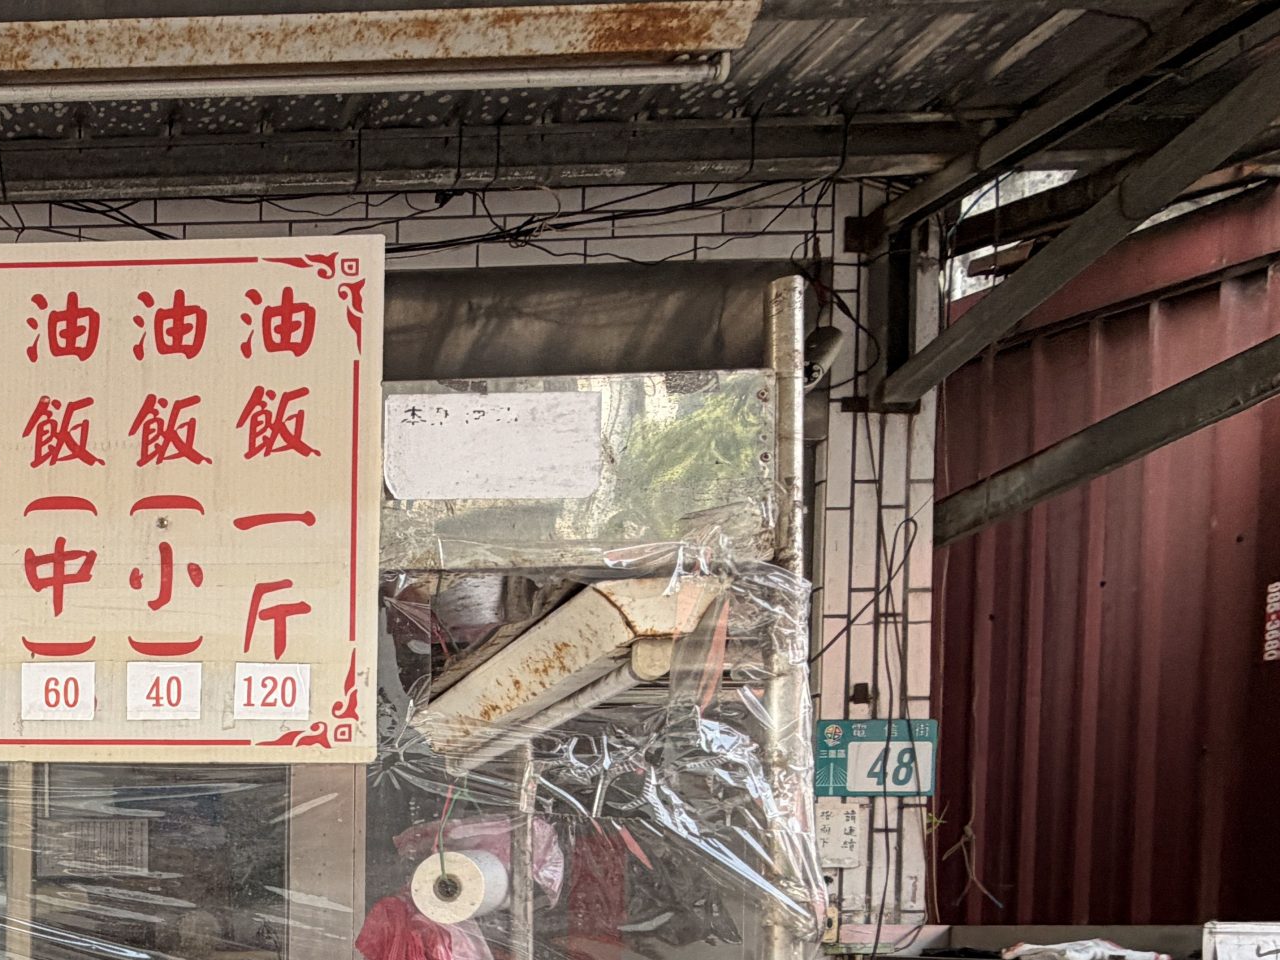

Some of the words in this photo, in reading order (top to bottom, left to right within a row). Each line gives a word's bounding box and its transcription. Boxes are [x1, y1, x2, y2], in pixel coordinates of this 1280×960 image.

[234, 286, 322, 661] 油飯一斤
[44, 677, 80, 708] 60
[146, 676, 182, 708] 40
[243, 676, 298, 708] 120
[851, 723, 929, 738] 電信街
[867, 747, 917, 787] 48
